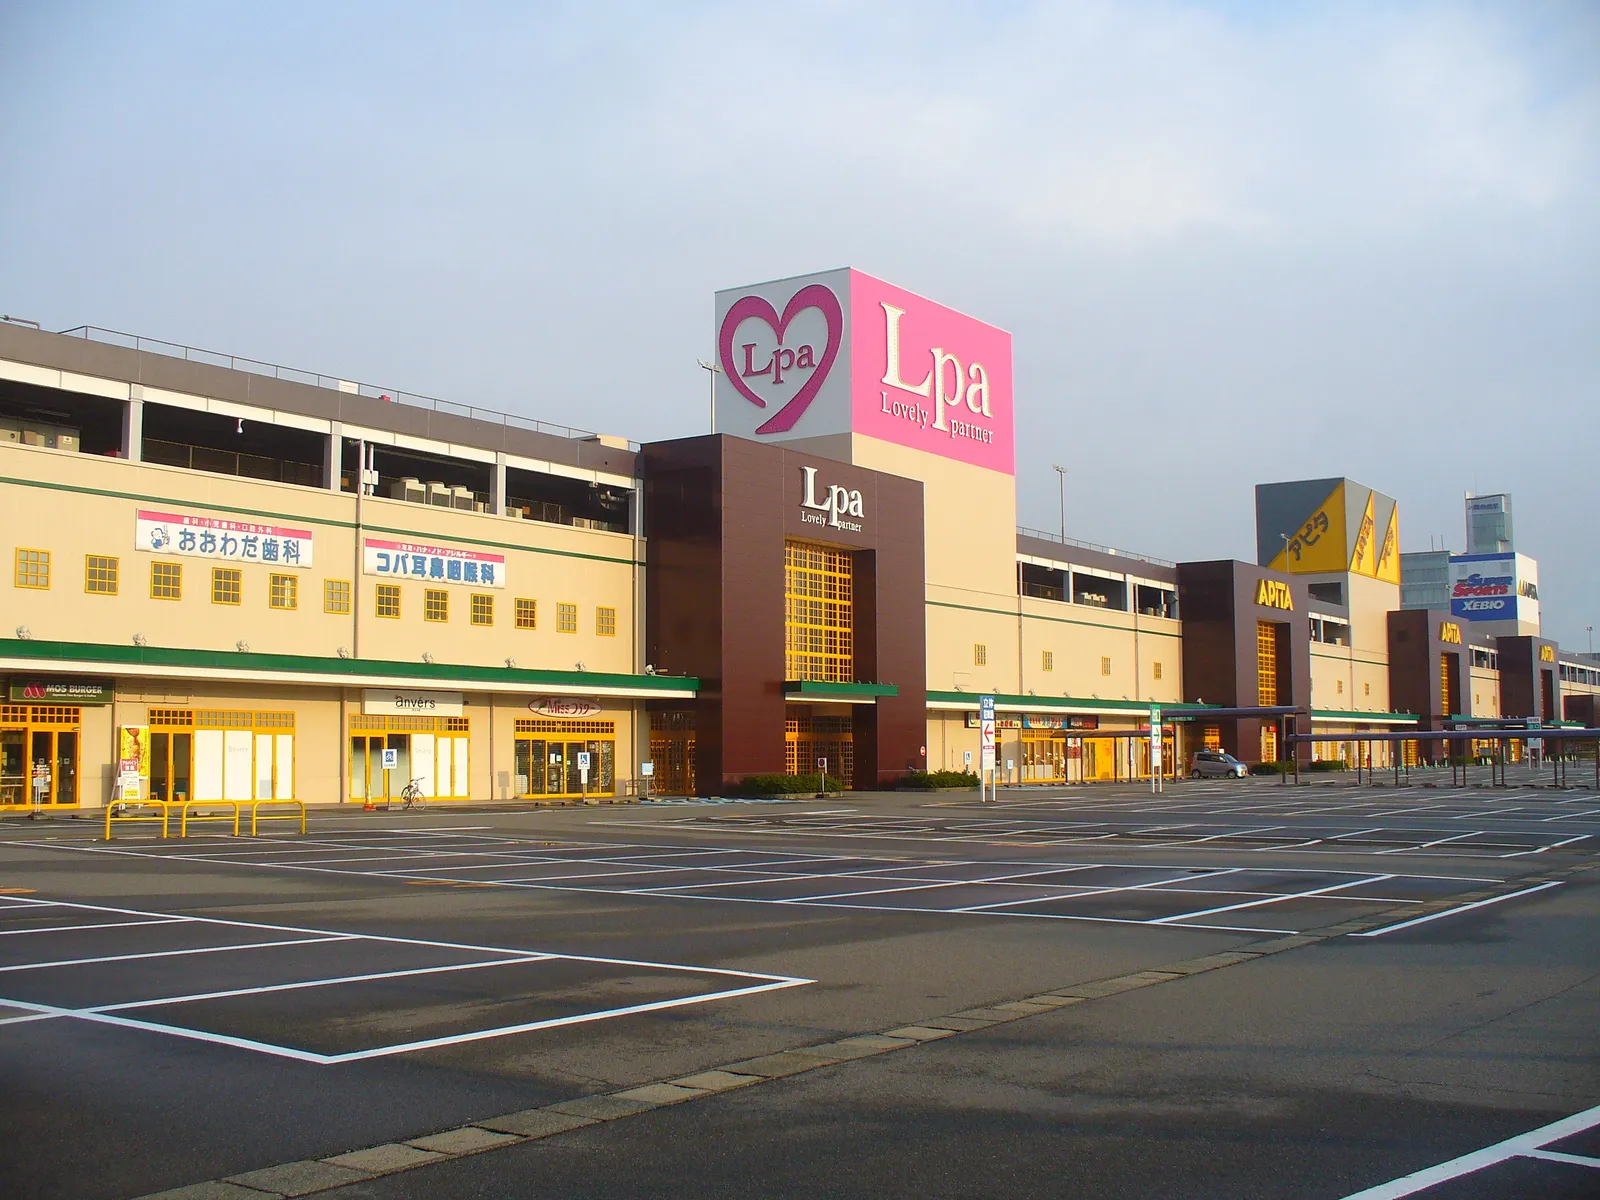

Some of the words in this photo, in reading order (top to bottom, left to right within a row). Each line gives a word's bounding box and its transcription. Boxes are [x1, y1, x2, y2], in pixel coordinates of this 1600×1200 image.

[741, 342, 816, 385] Lpa
[880, 301, 994, 432] Lpa
[881, 391, 929, 429] Lovely
[950, 418, 995, 444] partner
[800, 466, 865, 527] Lpa
[801, 510, 827, 528] Lovely
[837, 520, 862, 533] partner
[1287, 511, 1329, 562] アピタ
[178, 528, 301, 564] おおわだ歯科
[376, 552, 495, 585] コパ耳鼻咽喉科
[1256, 579, 1294, 611] APITA
[1461, 600, 1505, 611] XEBIO
[46, 684, 67, 694] MOS
[69, 685, 102, 694] BURGER
